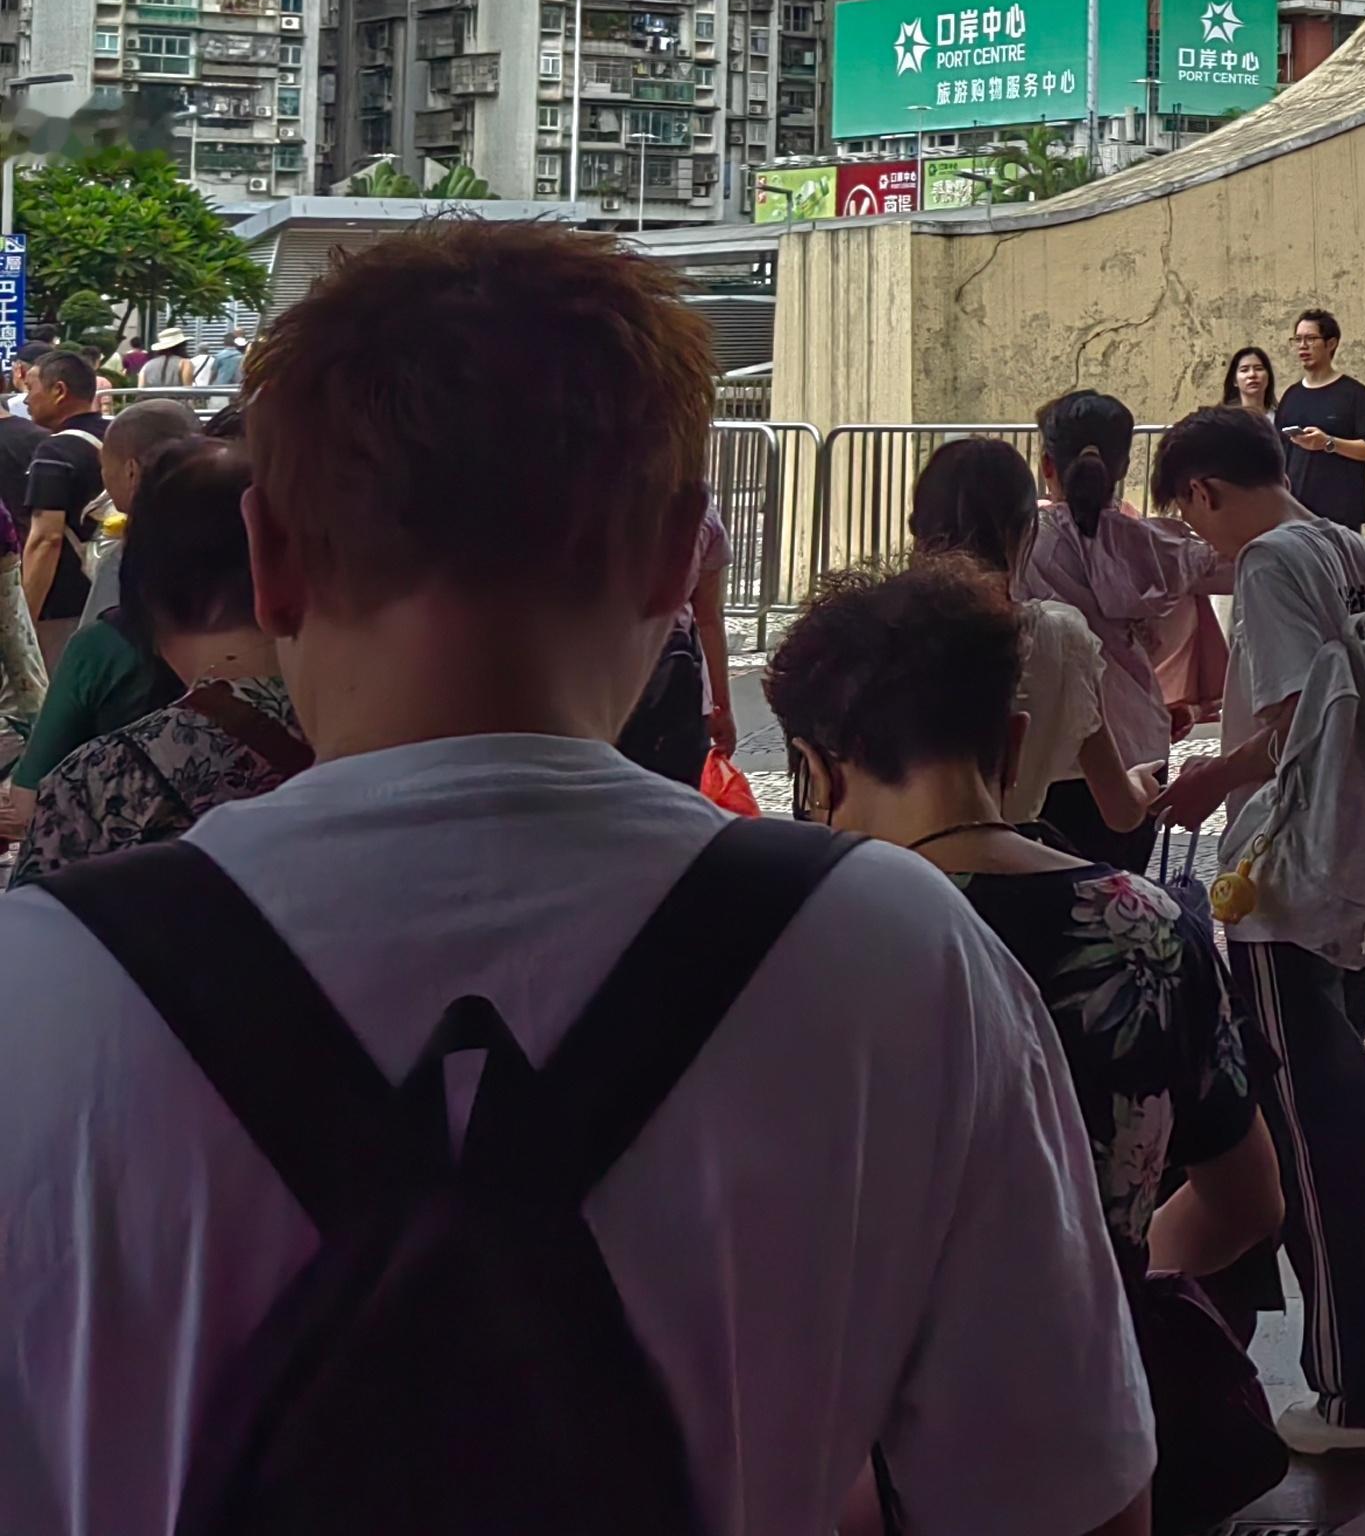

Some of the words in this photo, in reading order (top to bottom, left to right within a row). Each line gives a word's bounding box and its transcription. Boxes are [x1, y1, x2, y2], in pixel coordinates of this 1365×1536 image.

[937, 3, 1026, 47] 口岸中心
[937, 48, 971, 69] PORT
[973, 43, 1026, 66] CENTRE
[1178, 47, 1260, 72] 口岸中心
[936, 68, 1076, 105] 旅游购物服务中心
[1178, 69, 1211, 82] PORT
[1213, 71, 1260, 85] CENTRE
